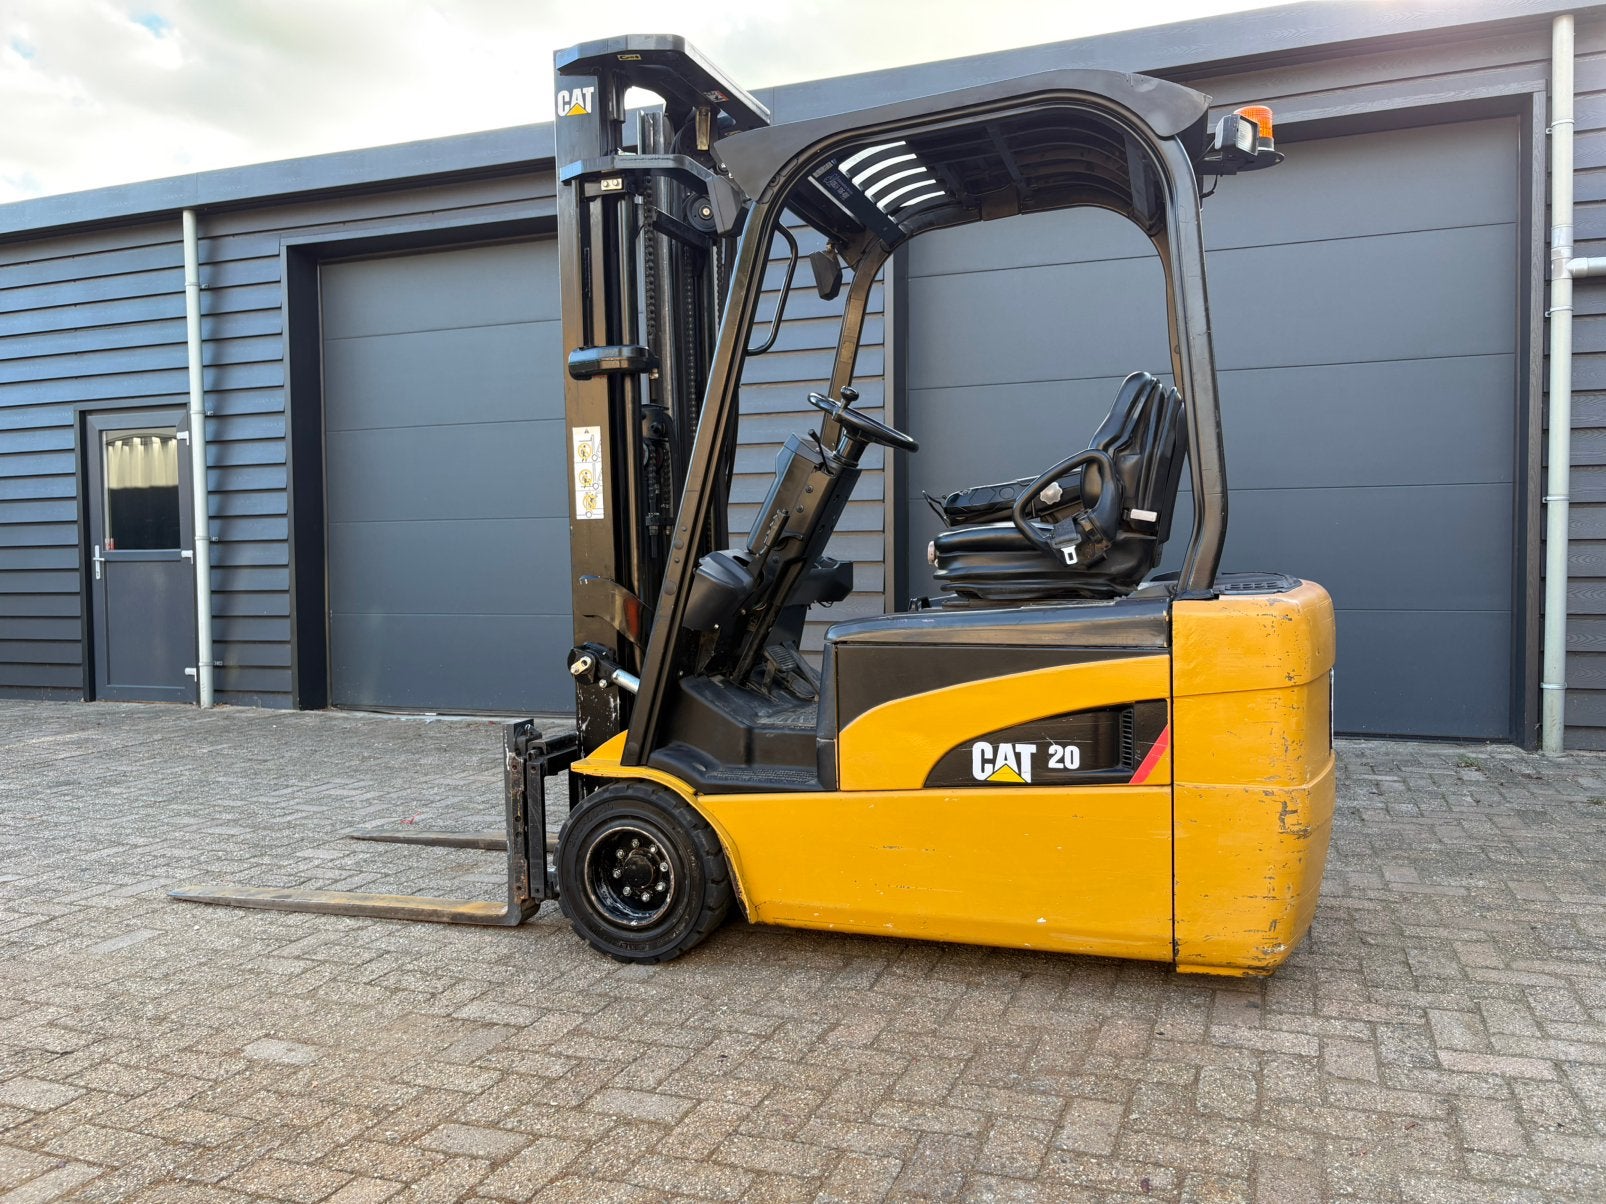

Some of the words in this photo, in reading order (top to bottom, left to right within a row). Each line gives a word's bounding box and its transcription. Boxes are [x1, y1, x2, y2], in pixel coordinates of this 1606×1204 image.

[557, 86, 595, 117] CAT
[972, 741, 1037, 784] CAT
[1047, 744, 1081, 770] 20
